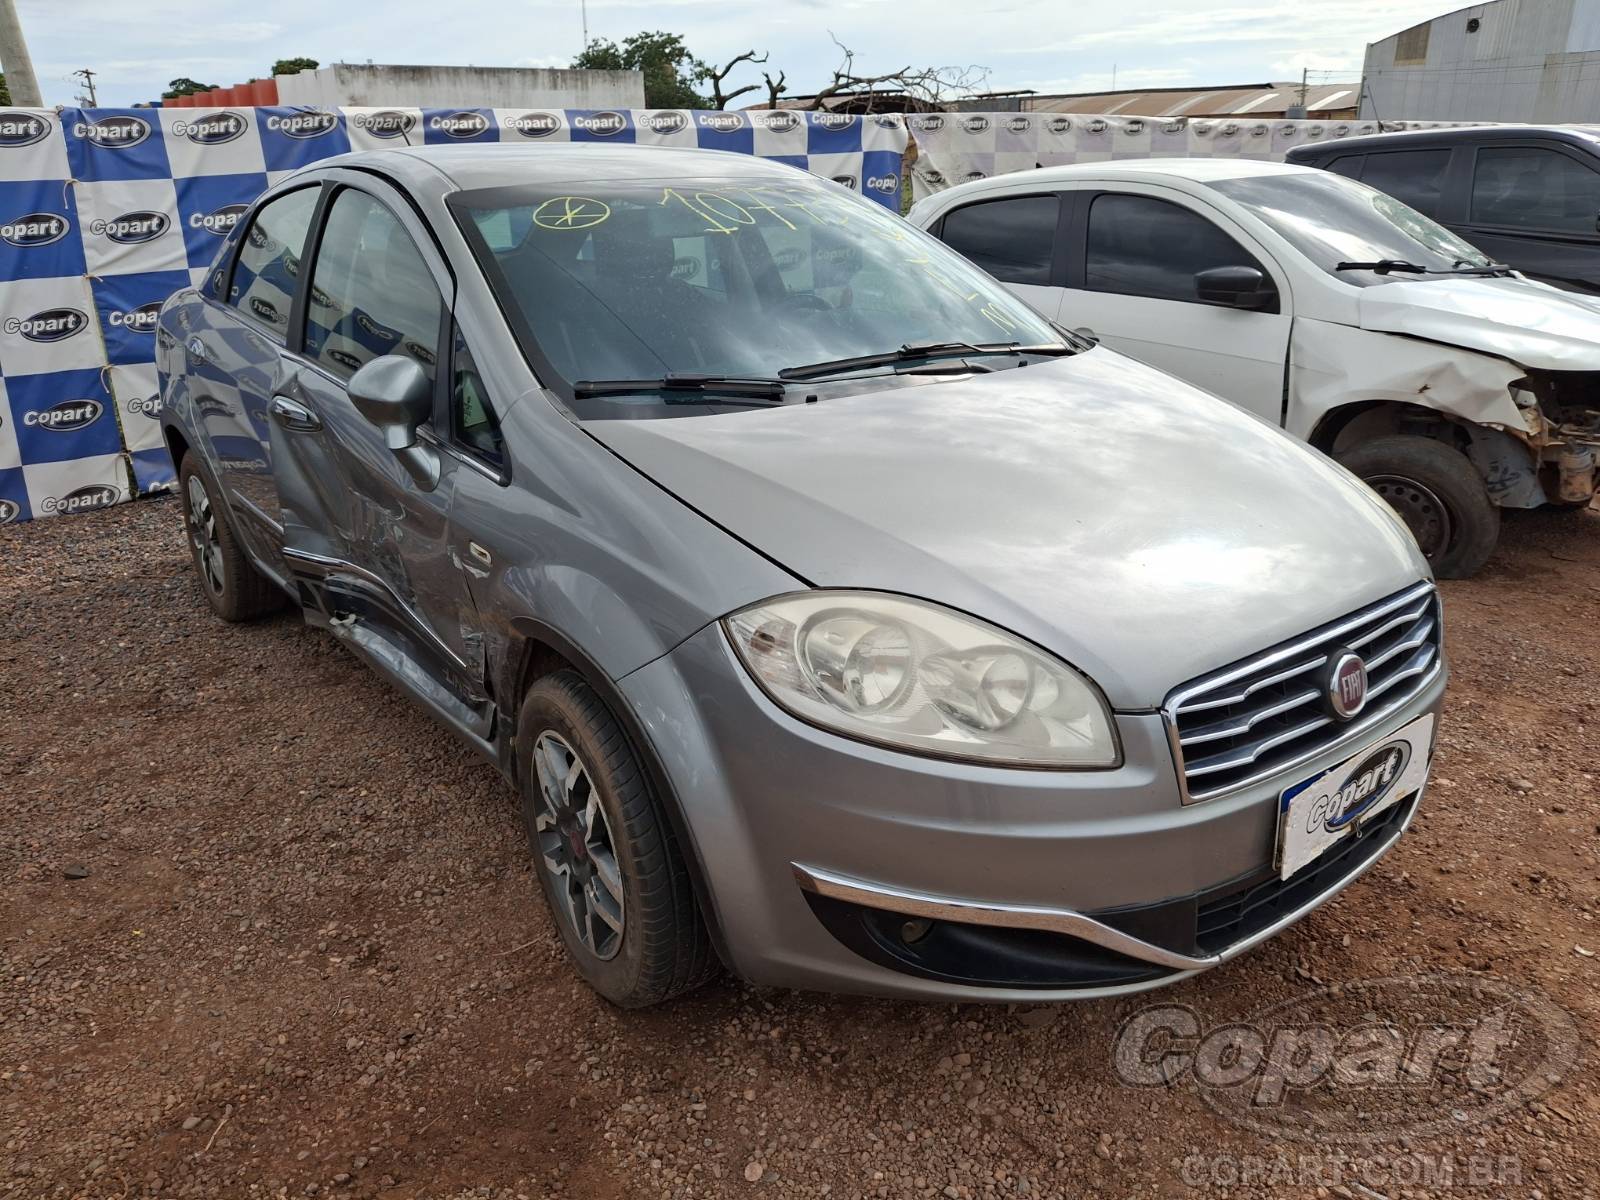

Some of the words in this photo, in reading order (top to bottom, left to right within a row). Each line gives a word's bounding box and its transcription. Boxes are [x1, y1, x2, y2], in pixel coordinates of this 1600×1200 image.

[0, 120, 38, 135] art
[172, 118, 237, 139] Copart
[267, 113, 330, 132] Copart
[353, 112, 408, 131] Copart
[430, 116, 482, 130] Copart
[504, 115, 553, 131] Copart
[574, 116, 620, 129] Copart
[639, 114, 681, 128] Copart
[699, 115, 739, 127] Copart
[753, 114, 794, 127] Copart
[811, 113, 850, 125] Copart
[911, 119, 942, 129] Copart
[73, 122, 140, 141] Copart
[0, 220, 59, 239] opart
[90, 216, 161, 237] Copart
[3, 313, 79, 335] Copart
[24, 404, 93, 425] Copart
[41, 489, 110, 512] Copart
[1341, 669, 1361, 703] FIAT
[1306, 748, 1399, 833] Copart
